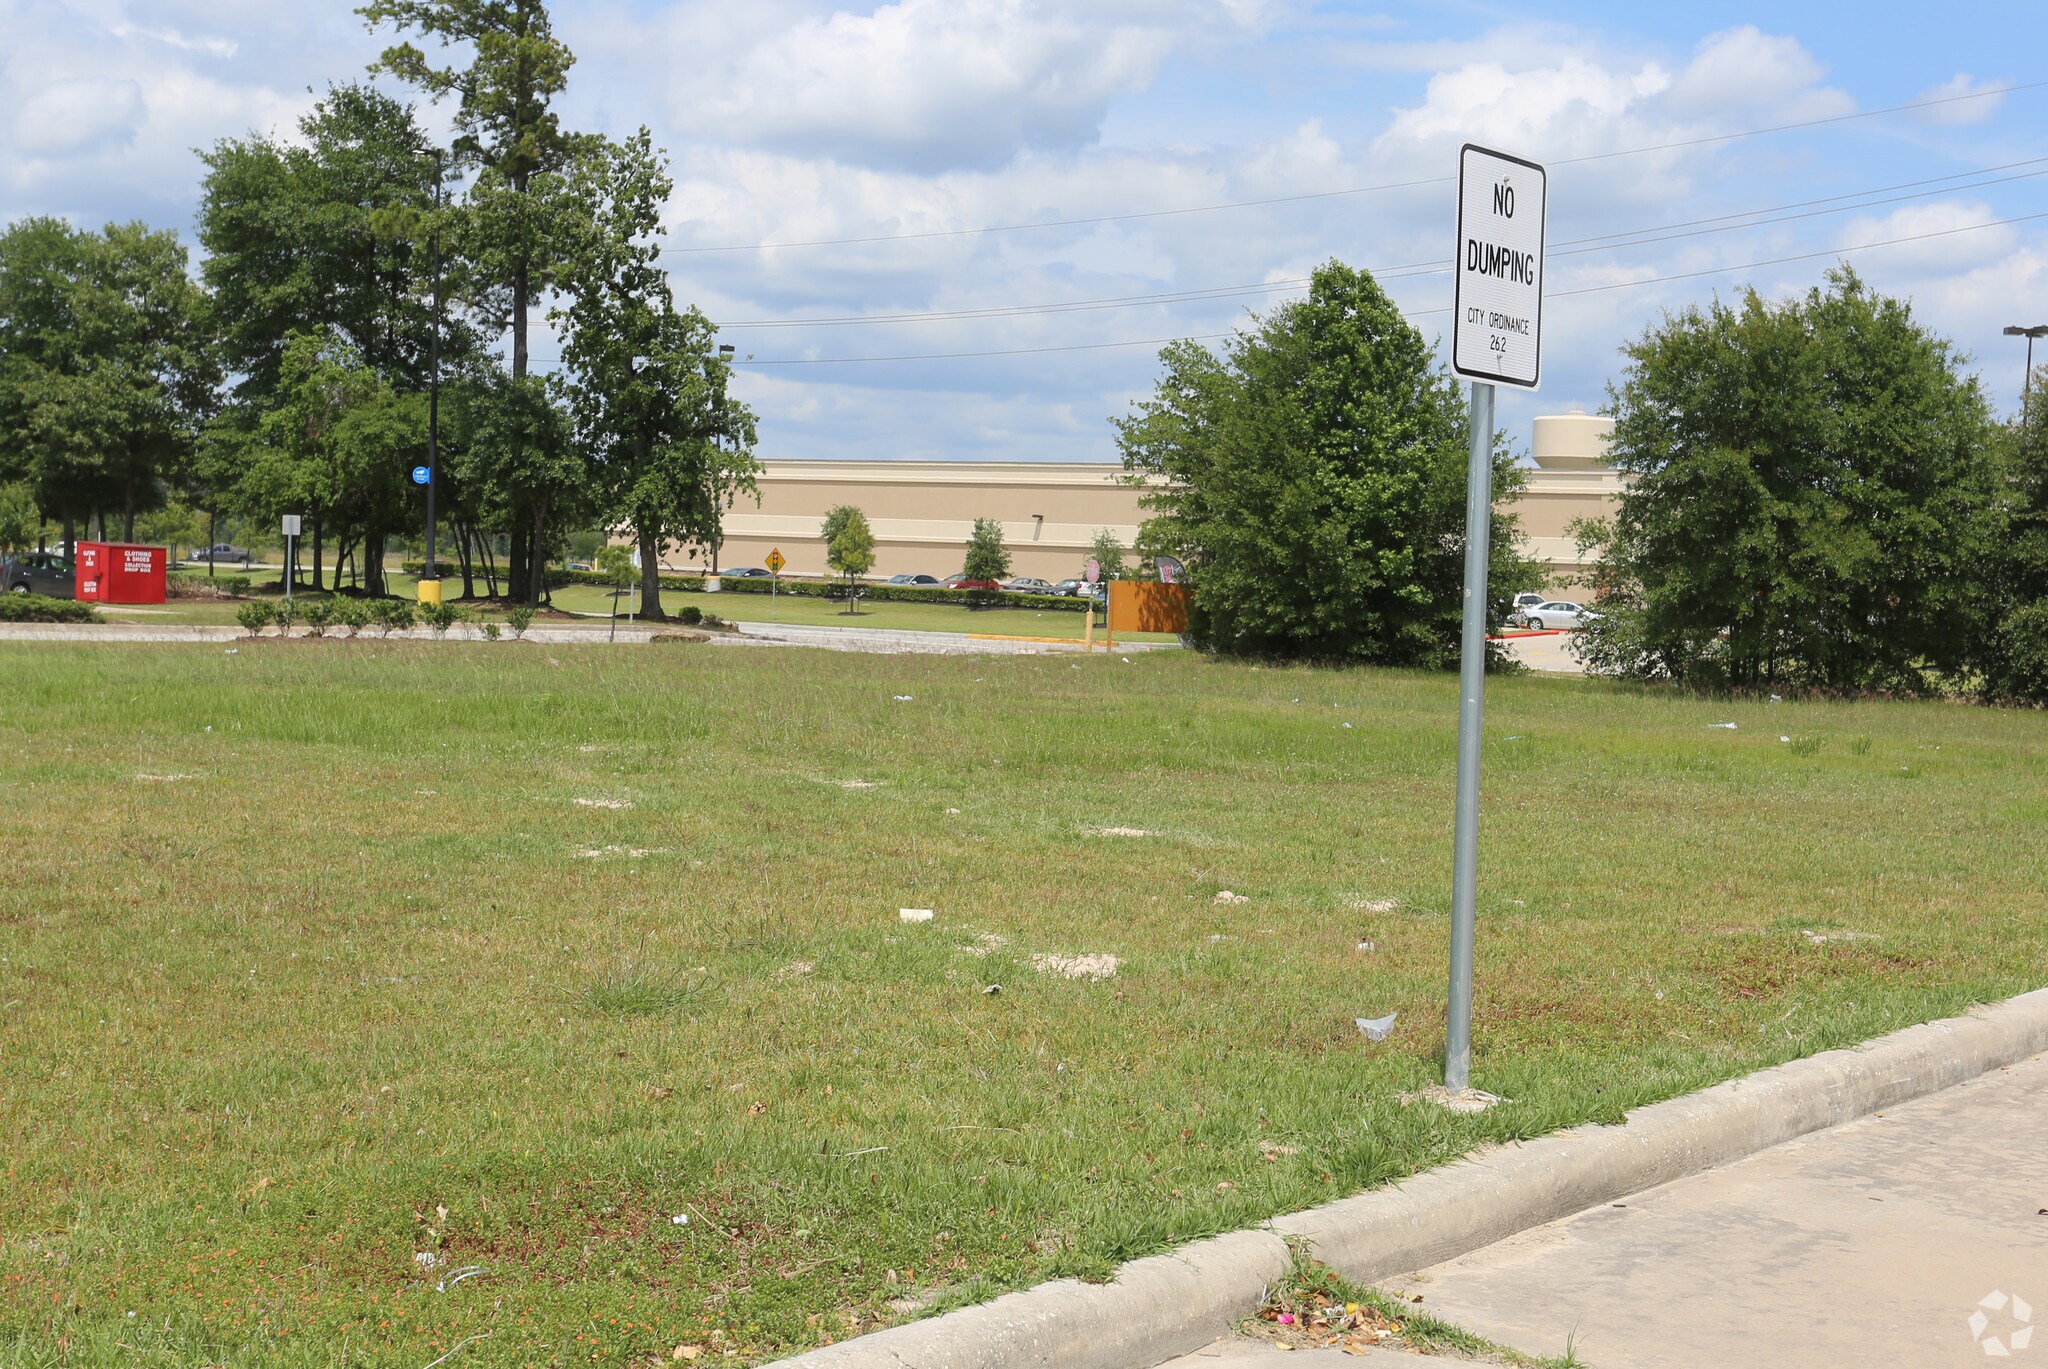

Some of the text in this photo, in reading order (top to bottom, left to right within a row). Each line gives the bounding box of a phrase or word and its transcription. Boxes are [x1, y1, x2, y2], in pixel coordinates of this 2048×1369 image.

[1493, 183, 1515, 219] NO
[1467, 239, 1534, 286] DUMPING
[1467, 307, 1530, 336] CITY ORDINANCE
